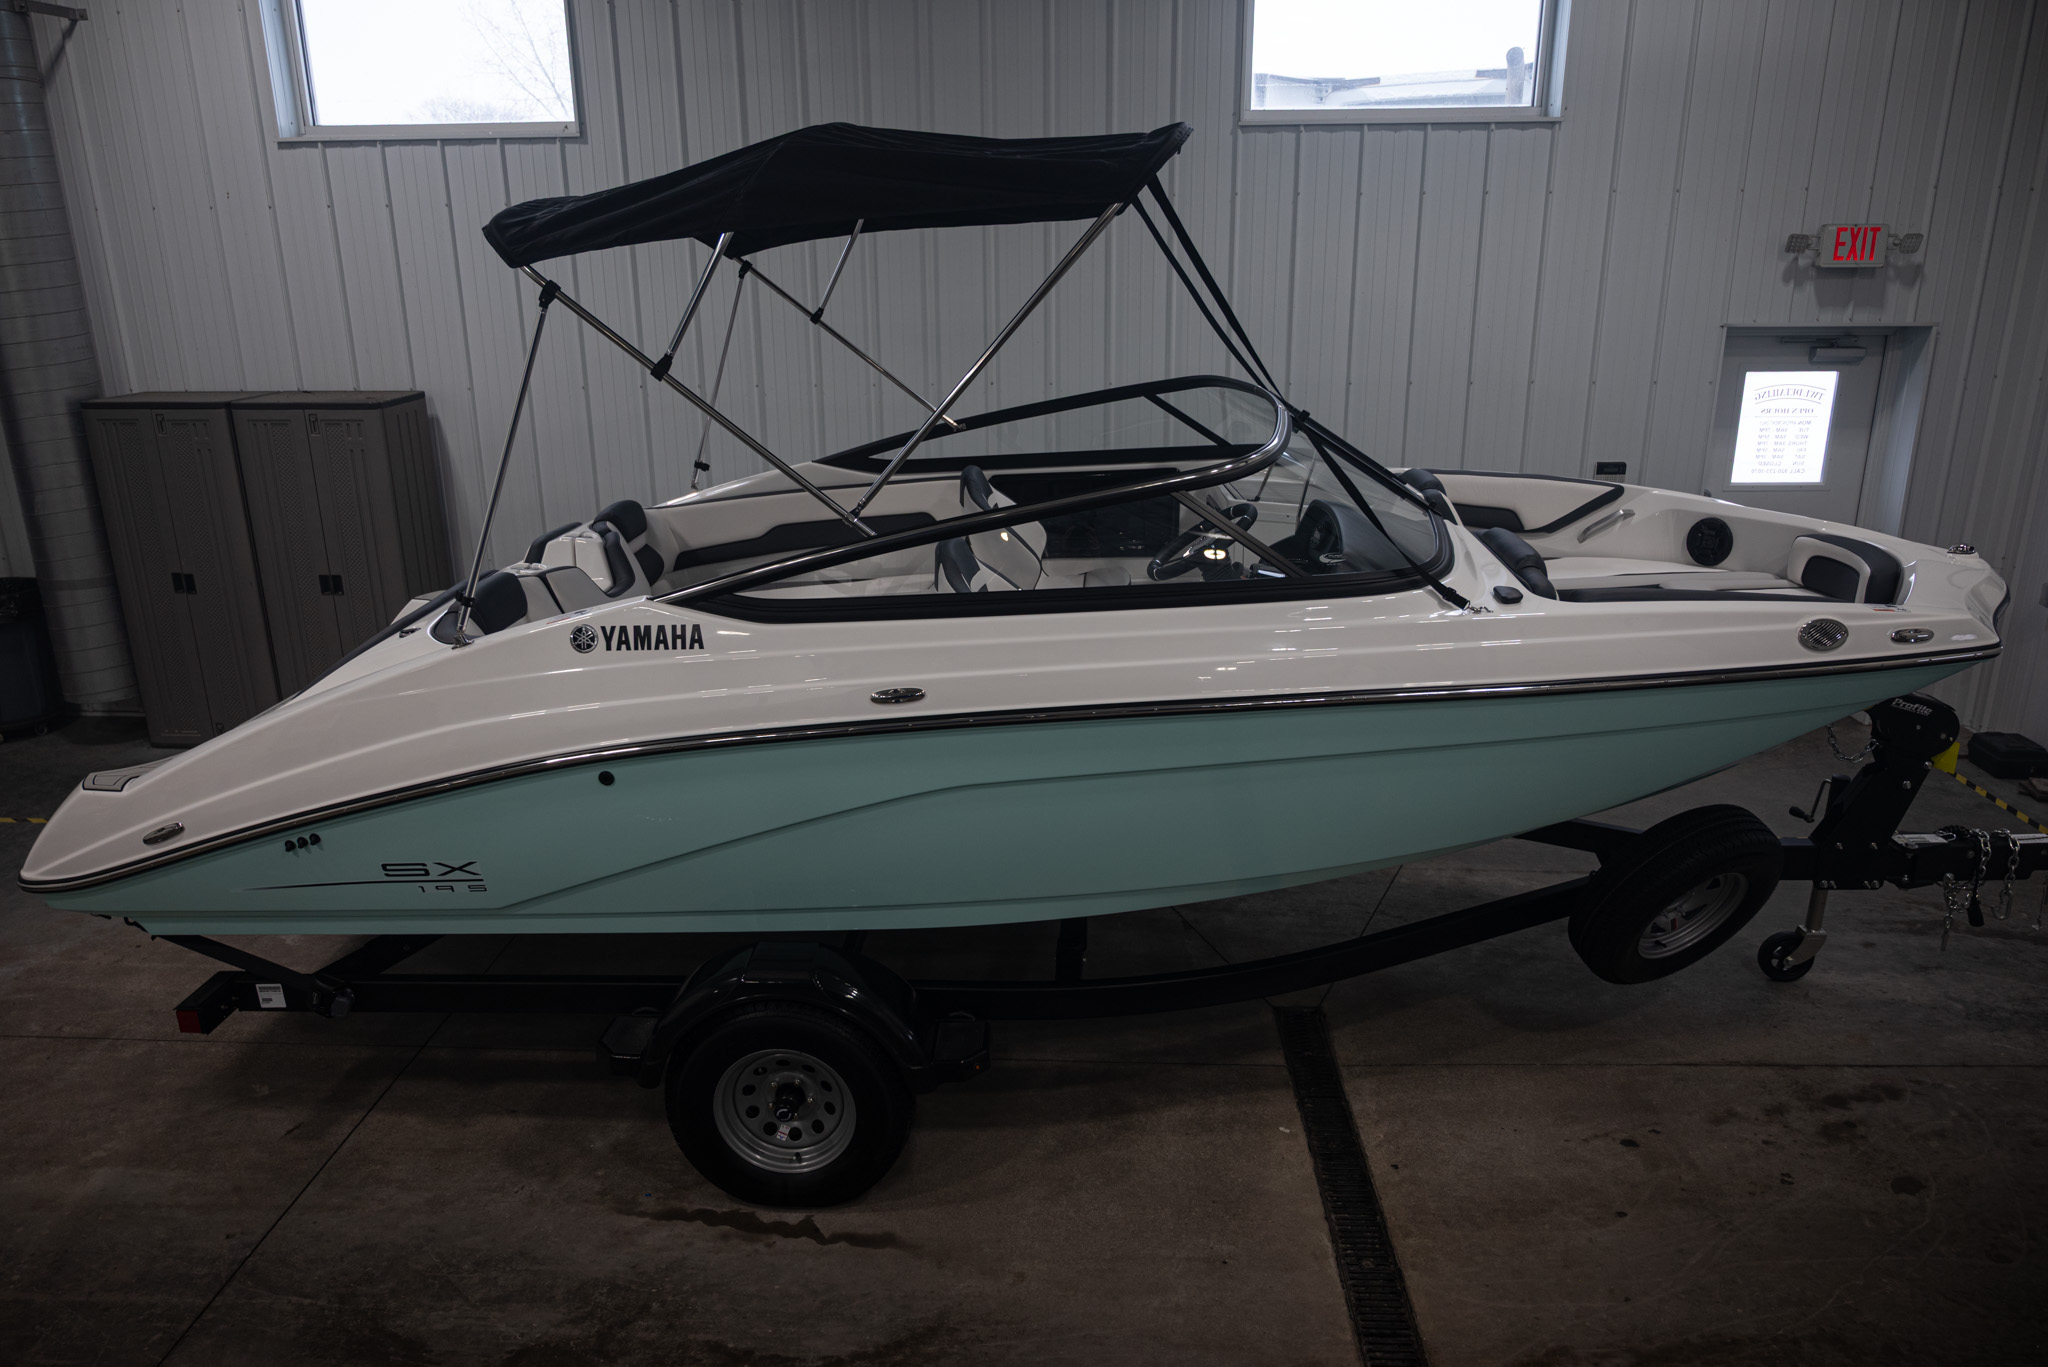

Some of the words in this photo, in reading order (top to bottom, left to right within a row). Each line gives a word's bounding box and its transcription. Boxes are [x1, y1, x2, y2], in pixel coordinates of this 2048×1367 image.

[1833, 227, 1881, 261] EXIT
[601, 624, 704, 651] YAMAHA
[1892, 698, 1933, 715] Profile
[381, 861, 482, 877] SX
[418, 885, 487, 893] 195
